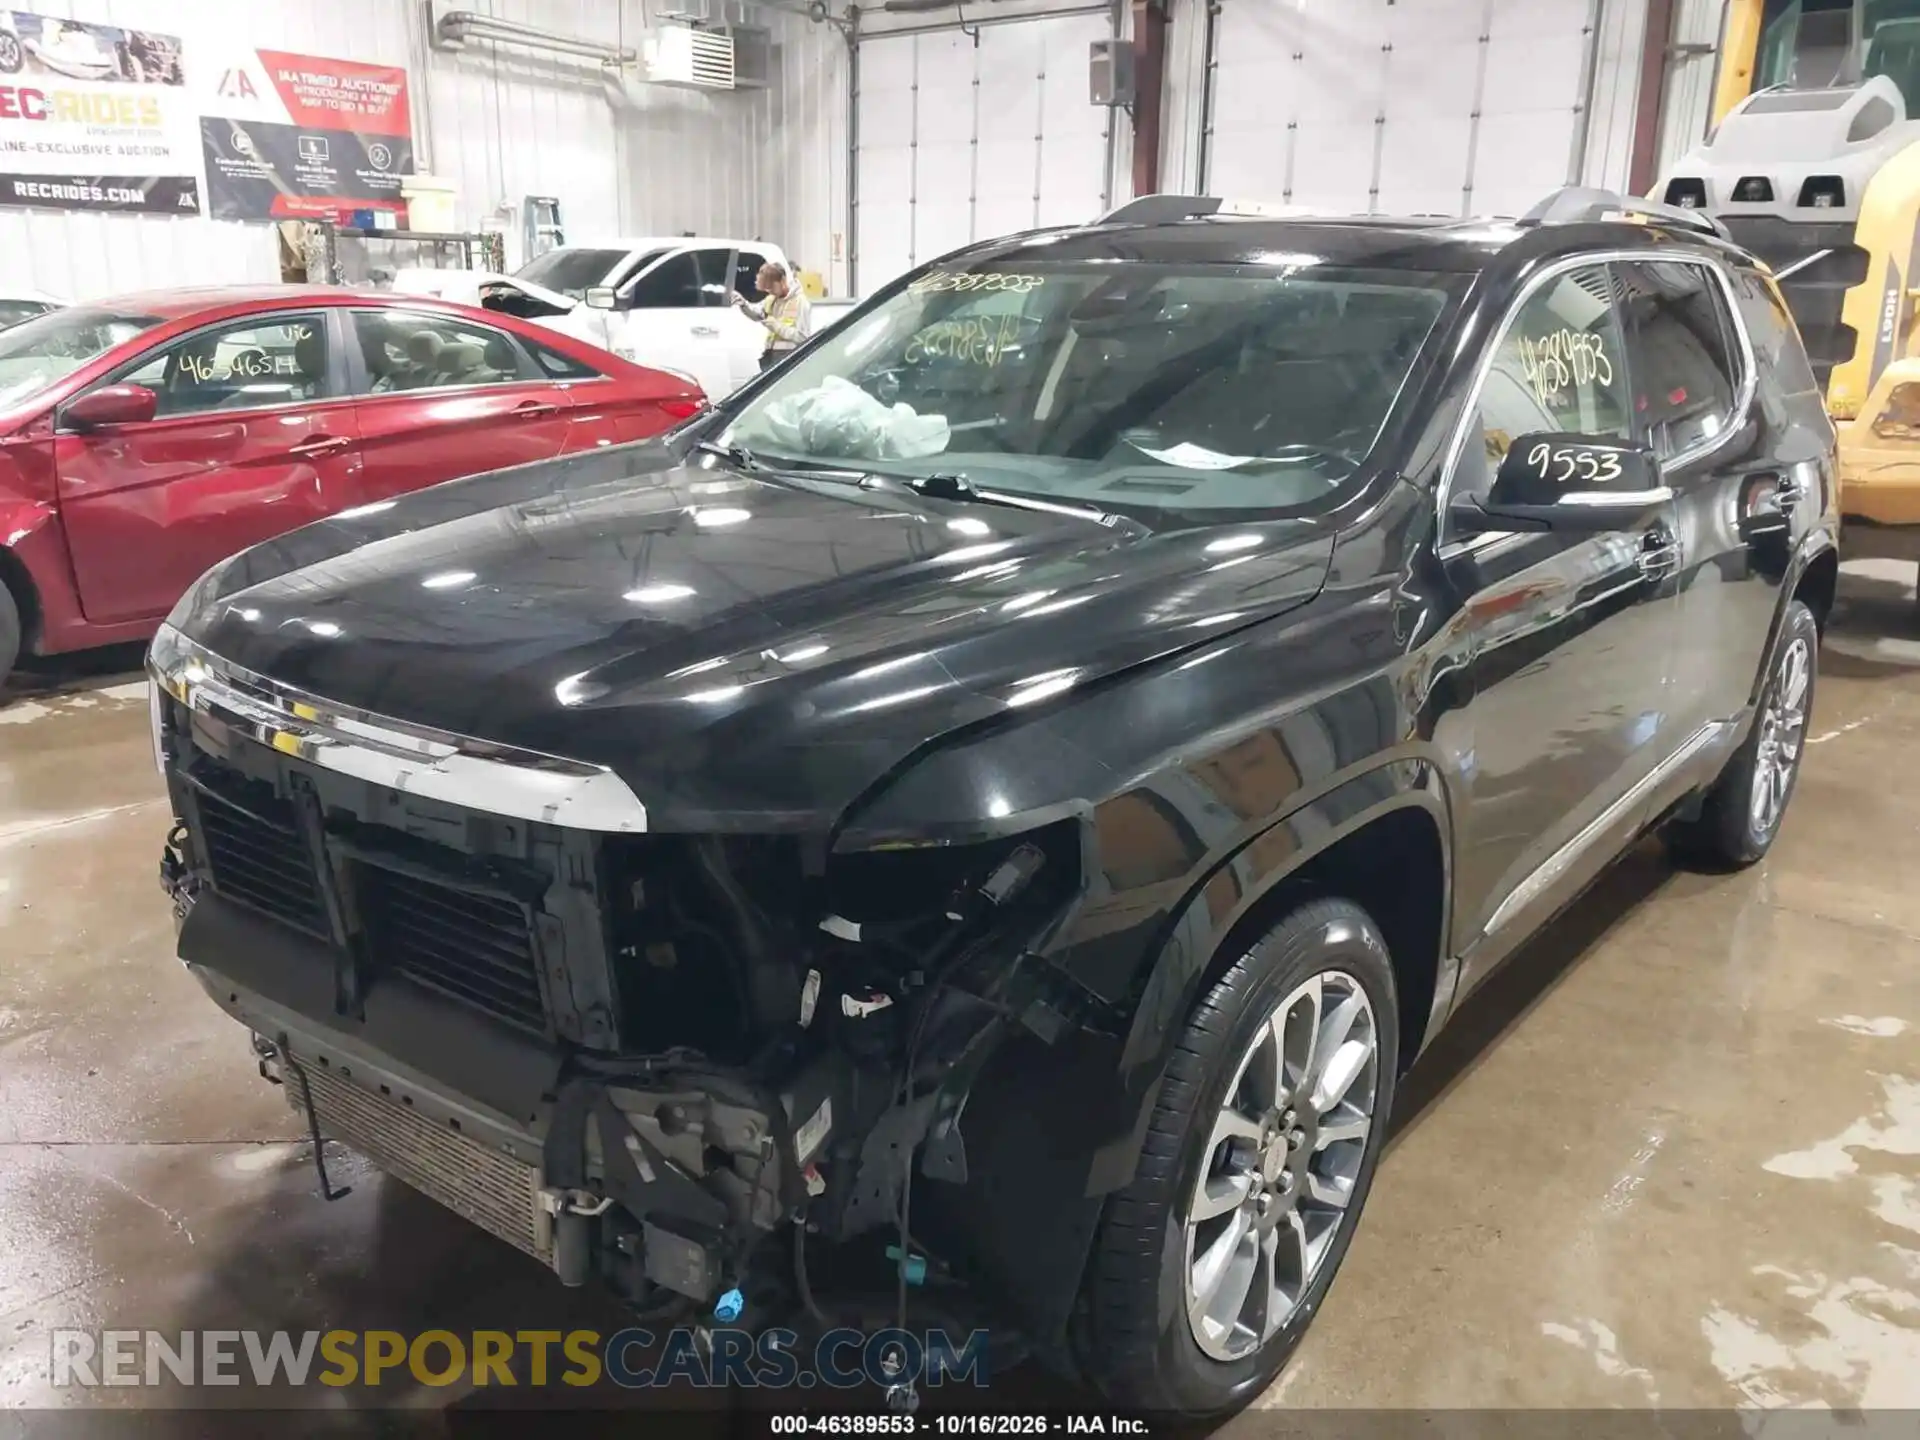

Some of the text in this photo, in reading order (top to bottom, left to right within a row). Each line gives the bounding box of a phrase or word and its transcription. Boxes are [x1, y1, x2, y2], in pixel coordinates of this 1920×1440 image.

[117, 145, 170, 157] AUCTION
[13, 181, 146, 203] RECRIDES.COM
[1528, 443, 1622, 482] 9553
